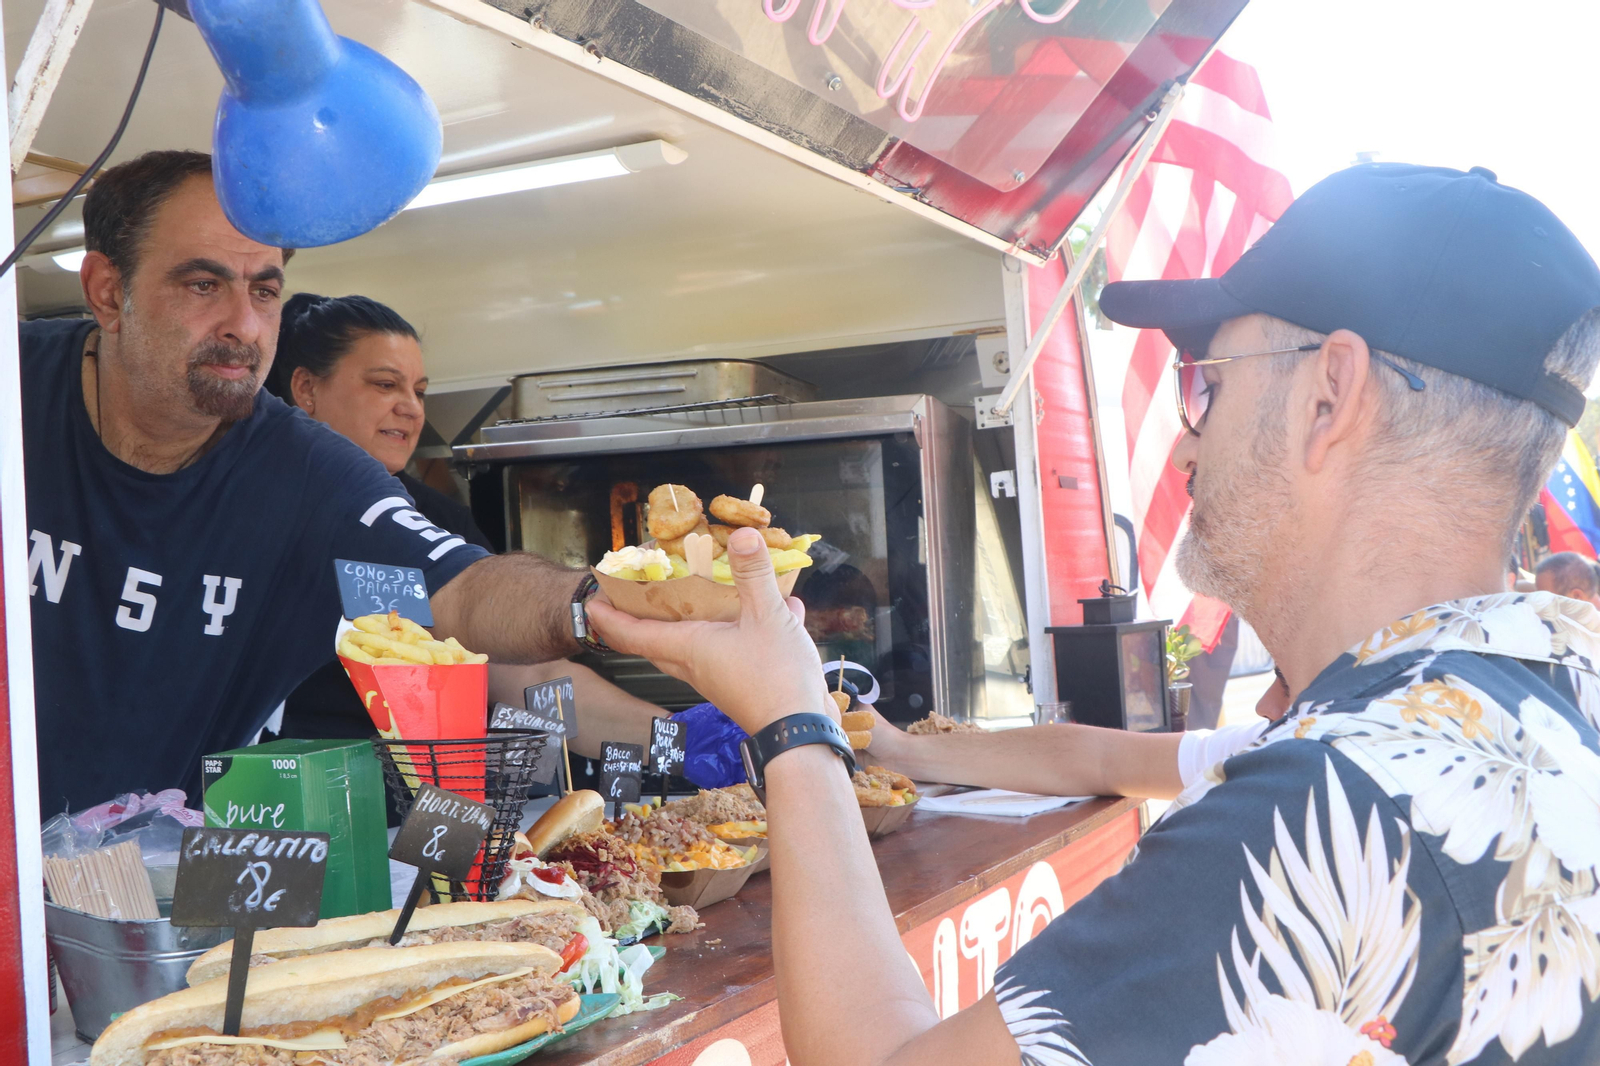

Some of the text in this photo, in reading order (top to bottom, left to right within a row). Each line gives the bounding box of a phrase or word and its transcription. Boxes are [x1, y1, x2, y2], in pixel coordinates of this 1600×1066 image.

[353, 577, 426, 600] PATATAS
[654, 718, 679, 736] PULLED
[655, 733, 675, 749] PORK
[271, 759, 297, 770] 1000
[657, 756, 673, 775] 7€
[226, 800, 286, 828] pure
[422, 825, 448, 861] 8€
[236, 861, 286, 911] 8€
